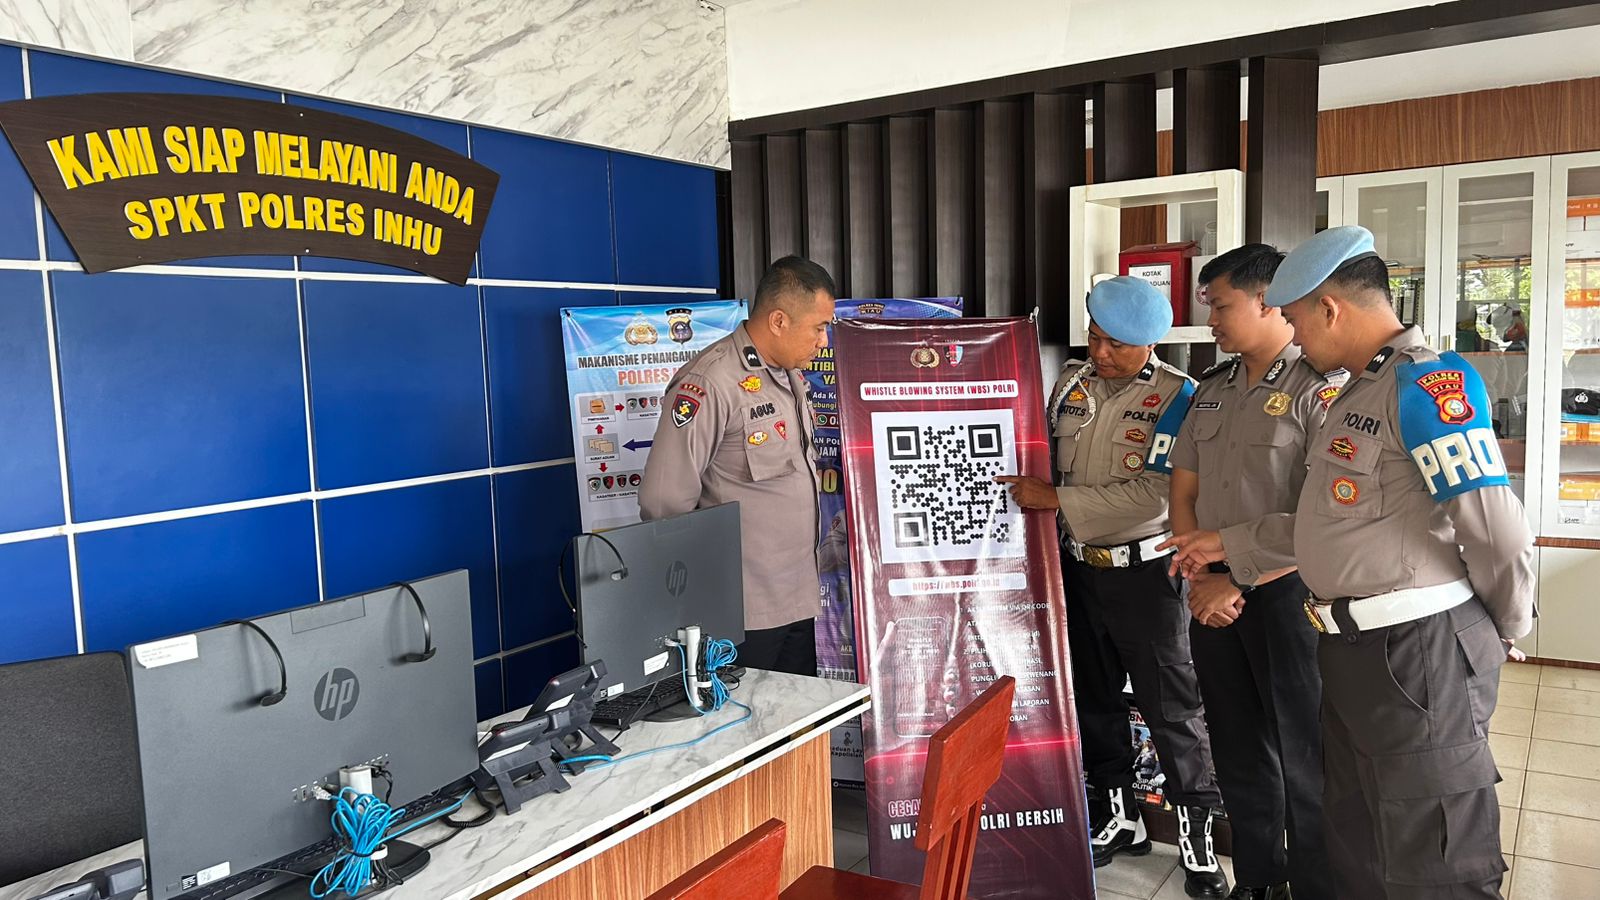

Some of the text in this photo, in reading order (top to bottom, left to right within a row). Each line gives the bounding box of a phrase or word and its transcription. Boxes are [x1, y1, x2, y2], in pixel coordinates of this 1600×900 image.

[47, 125, 475, 226] KAMI SIAP MELAYANI ANDA
[124, 192, 442, 256] SPKT POLRES INHU
[578, 350, 702, 369] MAKANISME PENANGANA
[617, 368, 670, 386] POLRES
[864, 384, 1015, 396] WHISTLE BLOWING SYSTEM (WBS) POLRI
[750, 402, 776, 420] AGUS
[1341, 412, 1381, 436] POLRI
[315, 667, 360, 721] hp
[888, 798, 921, 818] CEGA
[980, 812, 1011, 831] OLRI
[1016, 808, 1065, 828] BERSIH
